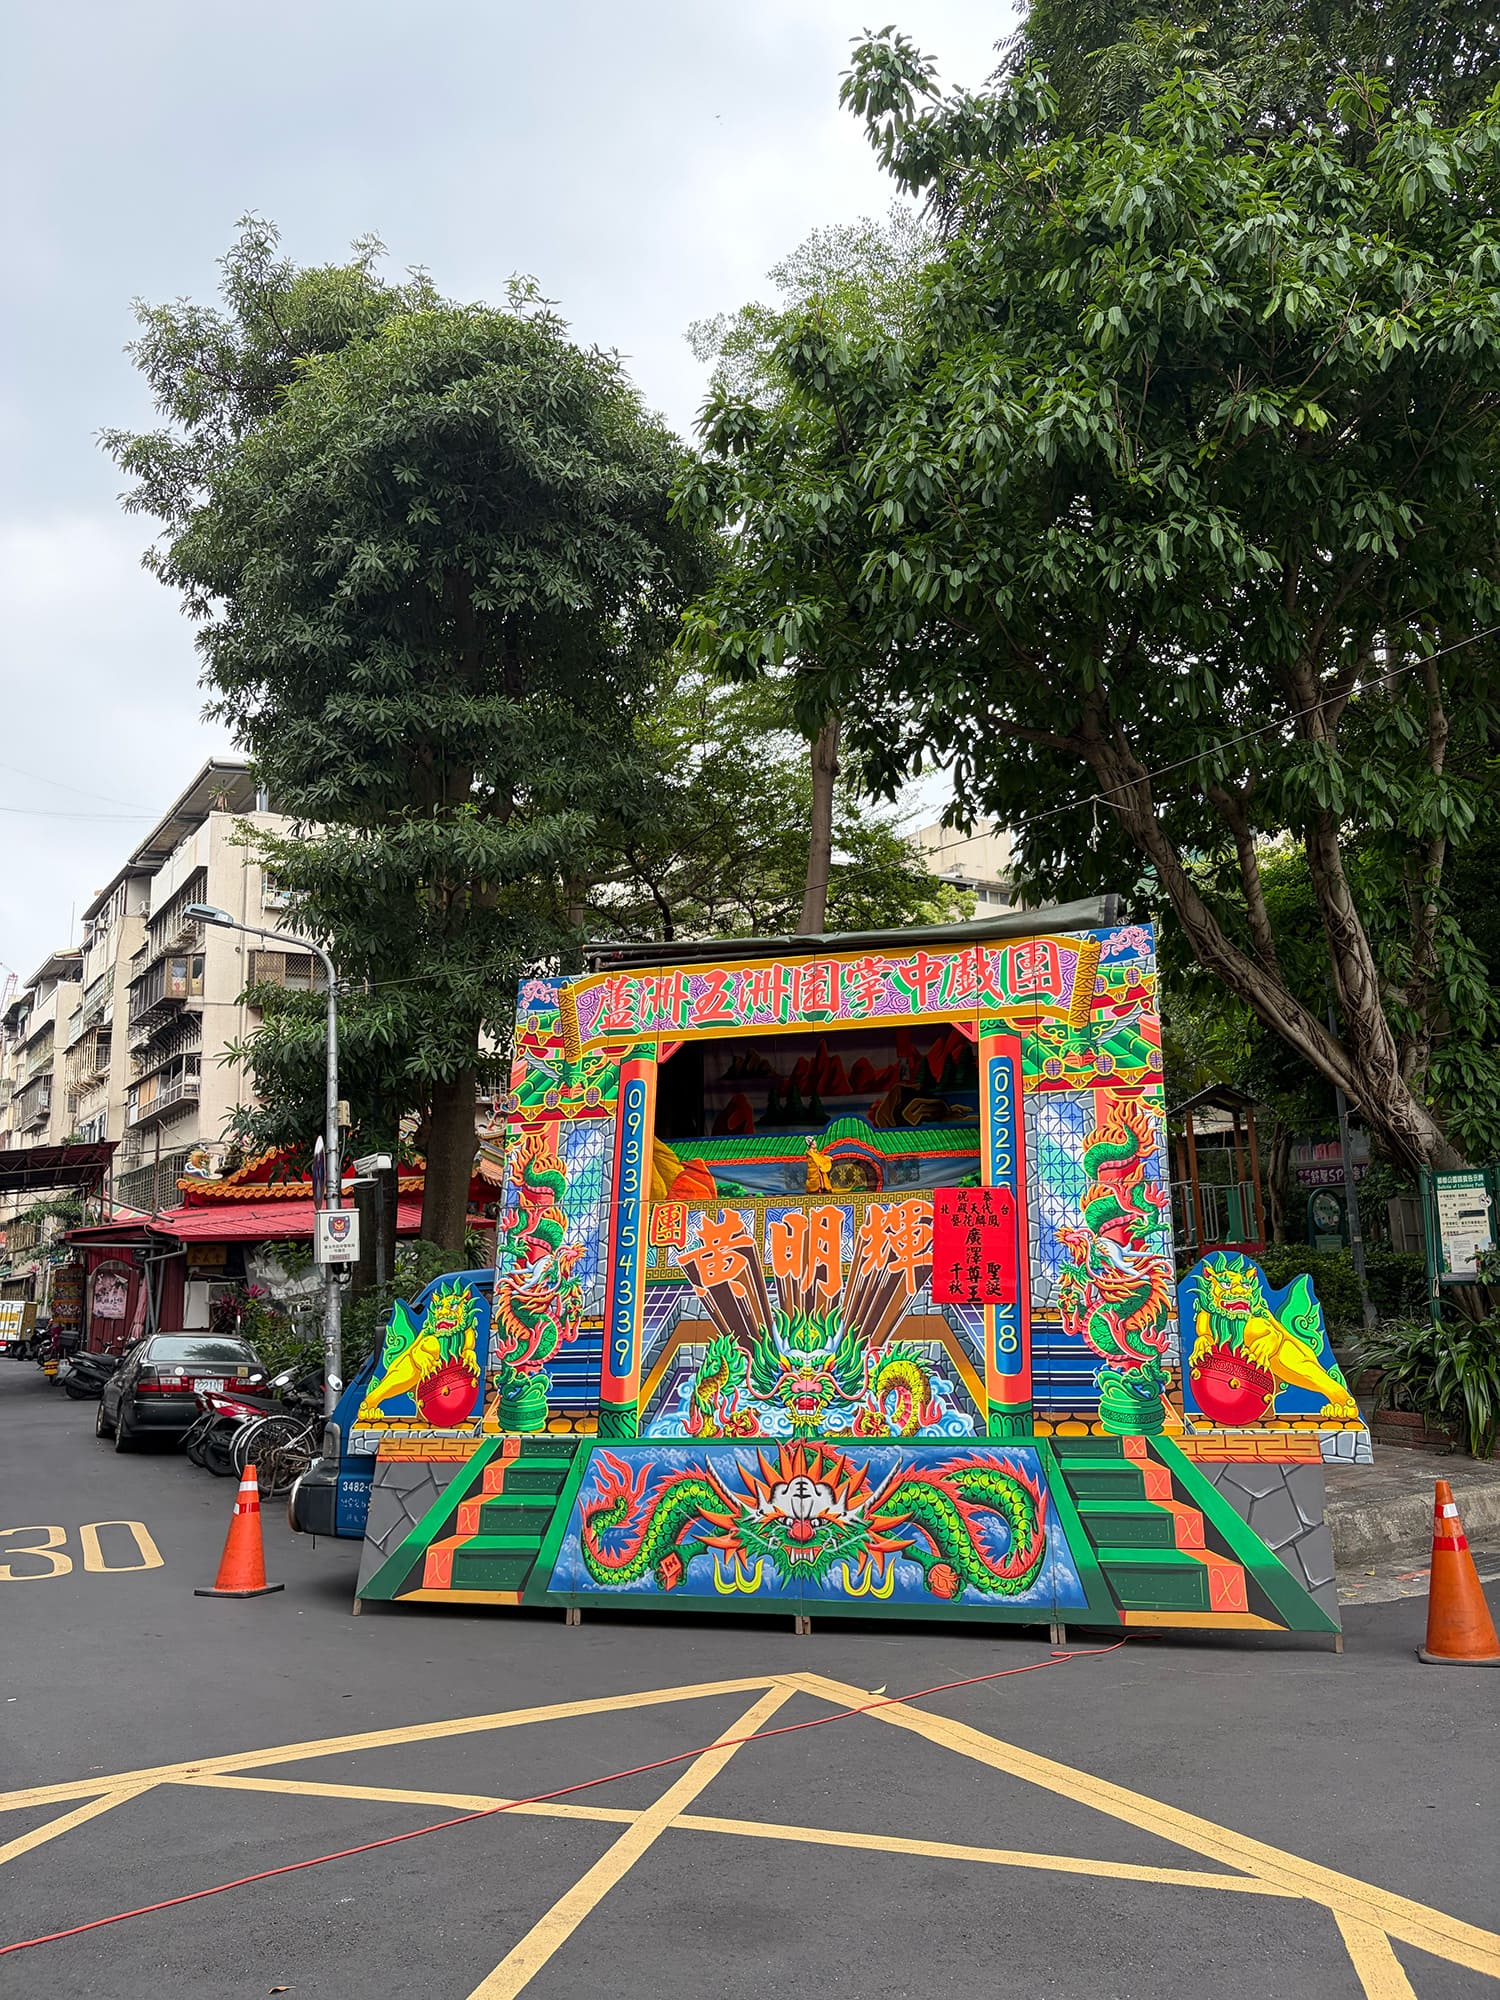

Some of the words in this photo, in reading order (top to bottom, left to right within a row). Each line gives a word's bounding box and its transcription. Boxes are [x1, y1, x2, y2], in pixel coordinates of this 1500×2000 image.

[588, 940, 1063, 1031] 蘆洲五洲園掌中戲團
[614, 1088, 642, 1366] 0933754339
[992, 1066, 1018, 1353] (02)2228
[948, 1262, 964, 1295] 千秋
[965, 1227, 982, 1303] 廣澤尊王
[0, 1520, 165, 1581] 30
